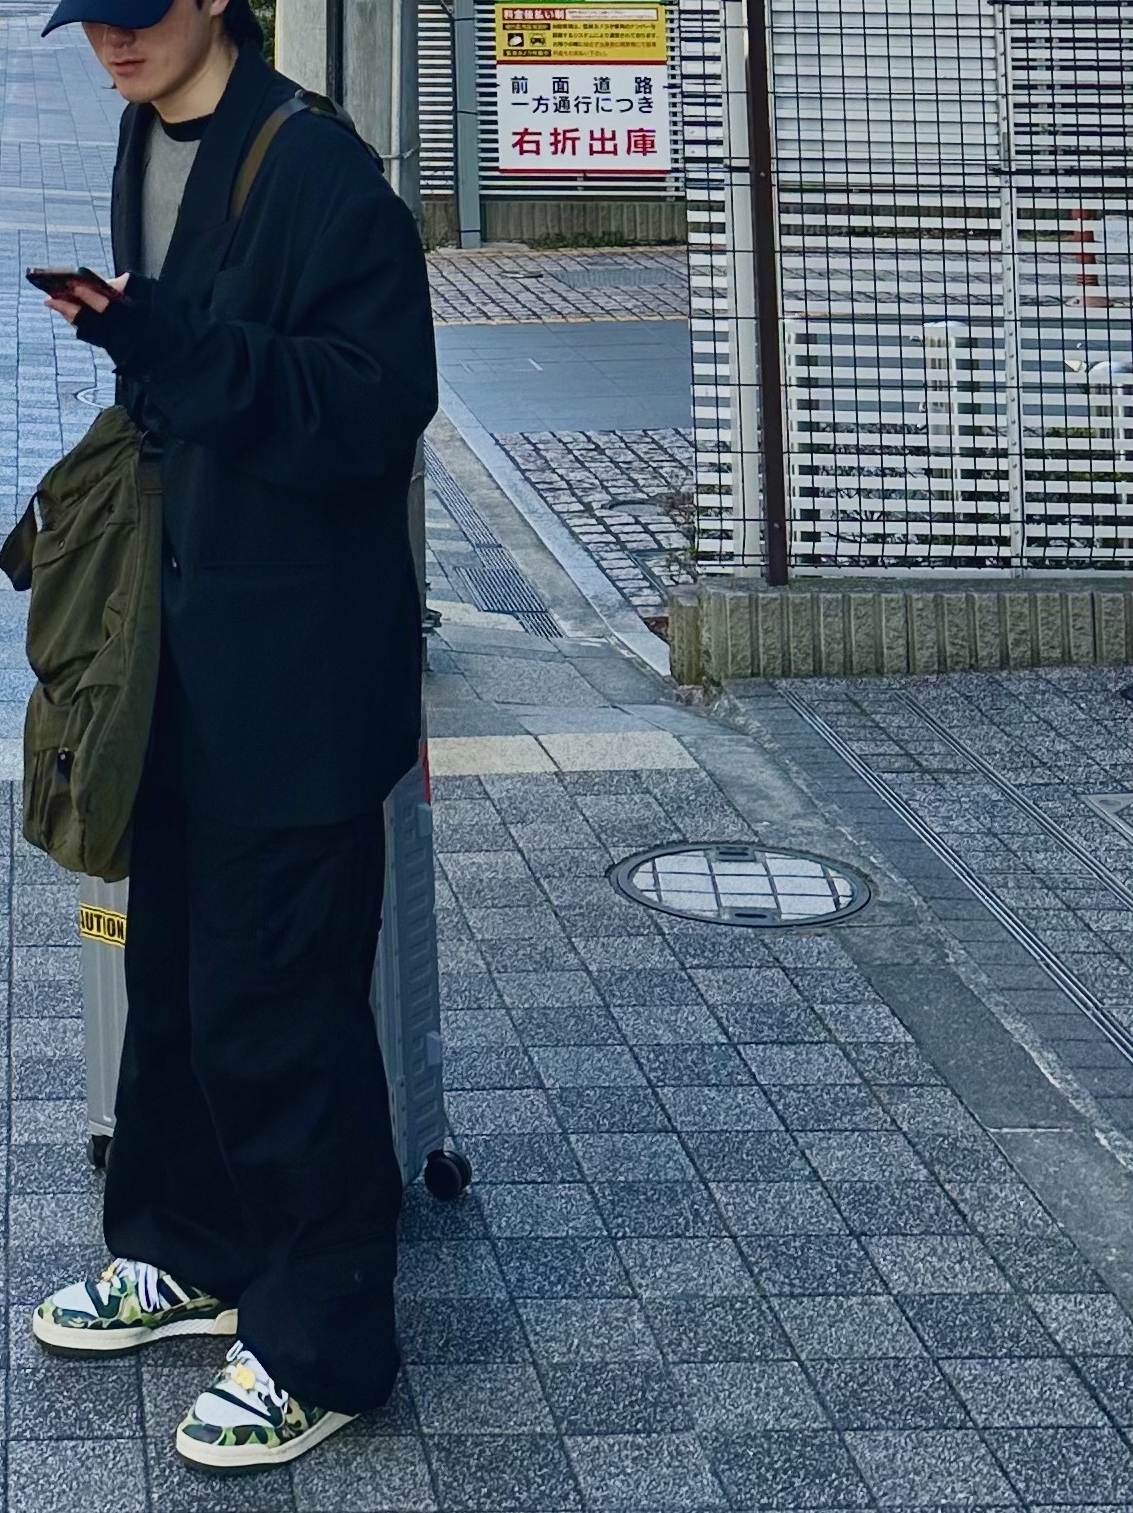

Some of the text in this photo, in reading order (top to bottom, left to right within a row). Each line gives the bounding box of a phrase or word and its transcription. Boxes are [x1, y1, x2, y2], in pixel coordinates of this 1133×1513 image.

[511, 95, 654, 114] 一方通行につき
[511, 127, 658, 157] 右折出庫
